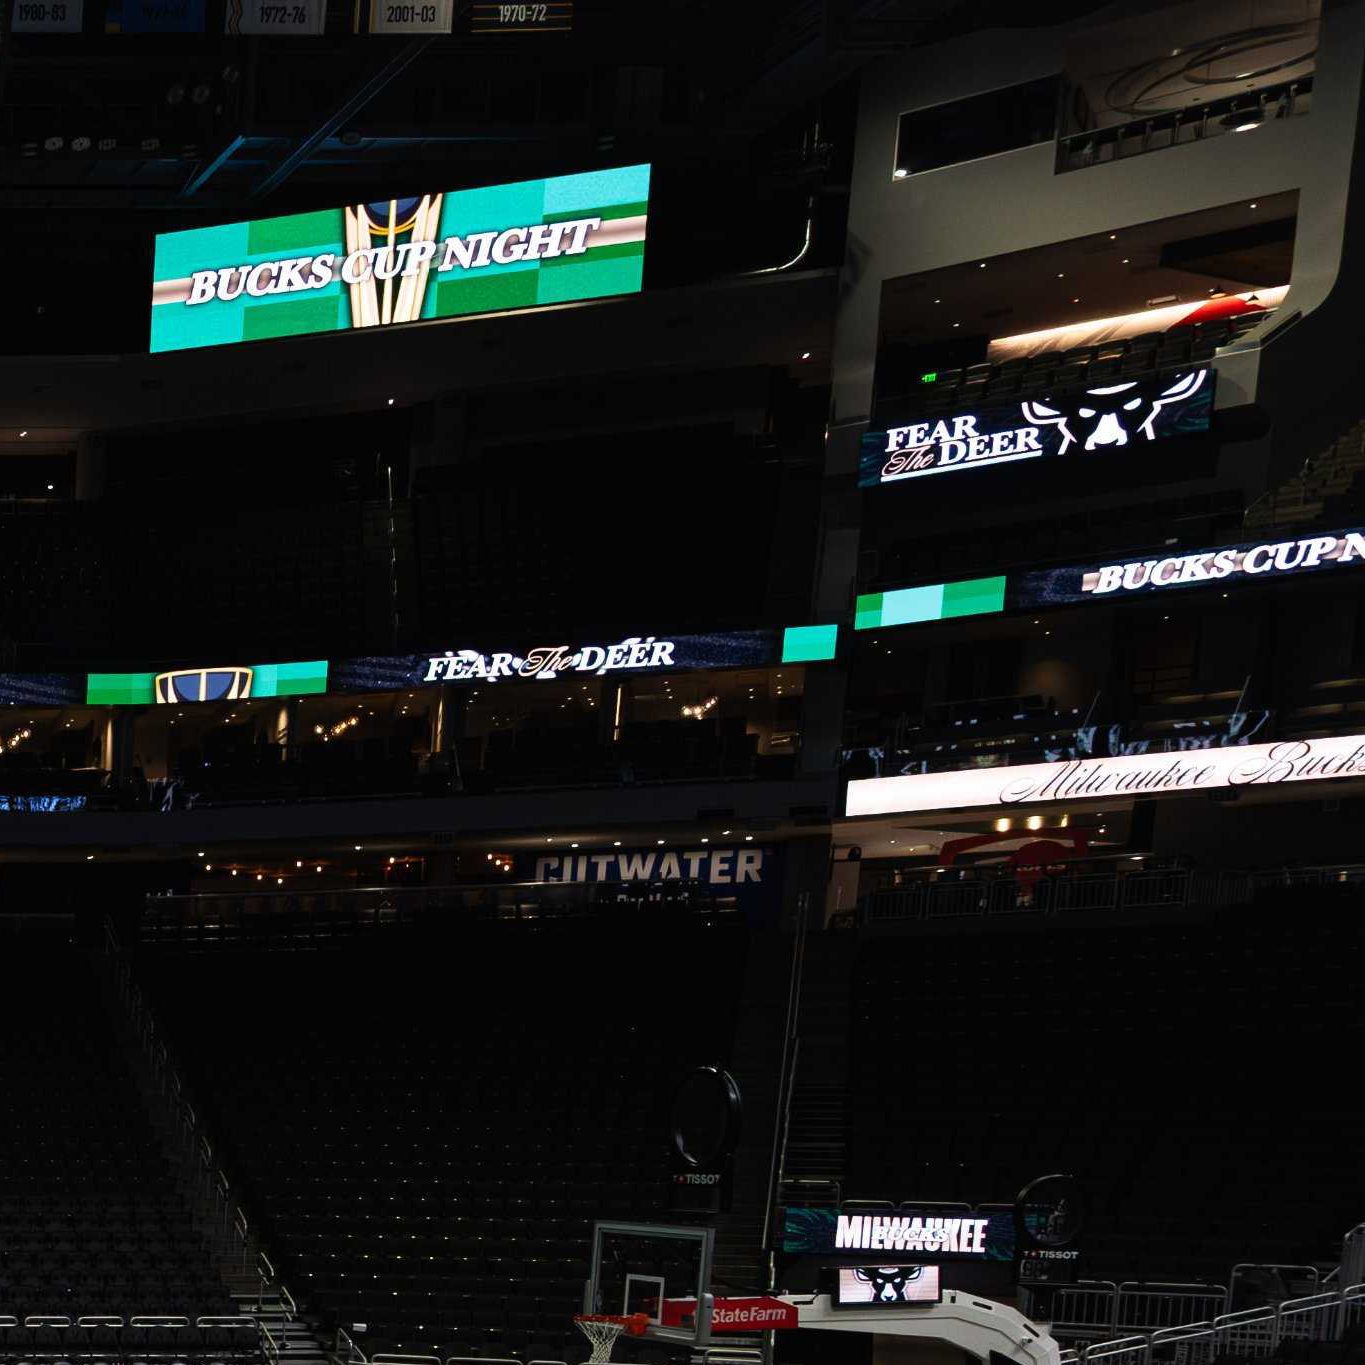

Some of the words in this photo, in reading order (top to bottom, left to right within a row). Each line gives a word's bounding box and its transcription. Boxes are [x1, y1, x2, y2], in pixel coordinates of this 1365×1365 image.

[387, 4, 436, 23] 2001-03
[185, 253, 335, 306] BUCKS
[341, 239, 438, 283] CUP
[438, 217, 601, 273] NIGHT
[880, 446, 934, 477] The
[937, 427, 1043, 467] DEER
[884, 415, 981, 453] FEAR
[1092, 549, 1238, 594] BUCKS
[1242, 536, 1337, 574] CUP
[424, 652, 514, 682] FEAR
[519, 645, 570, 677] The
[575, 641, 675, 671] DEER
[999, 759, 1217, 804] Milwaukee
[685, 1173, 723, 1185] TISSOT
[834, 1215, 989, 1253] MILWAUKEE
[871, 1226, 949, 1243] BUCKS
[1038, 1249, 1080, 1261] TISSOT
